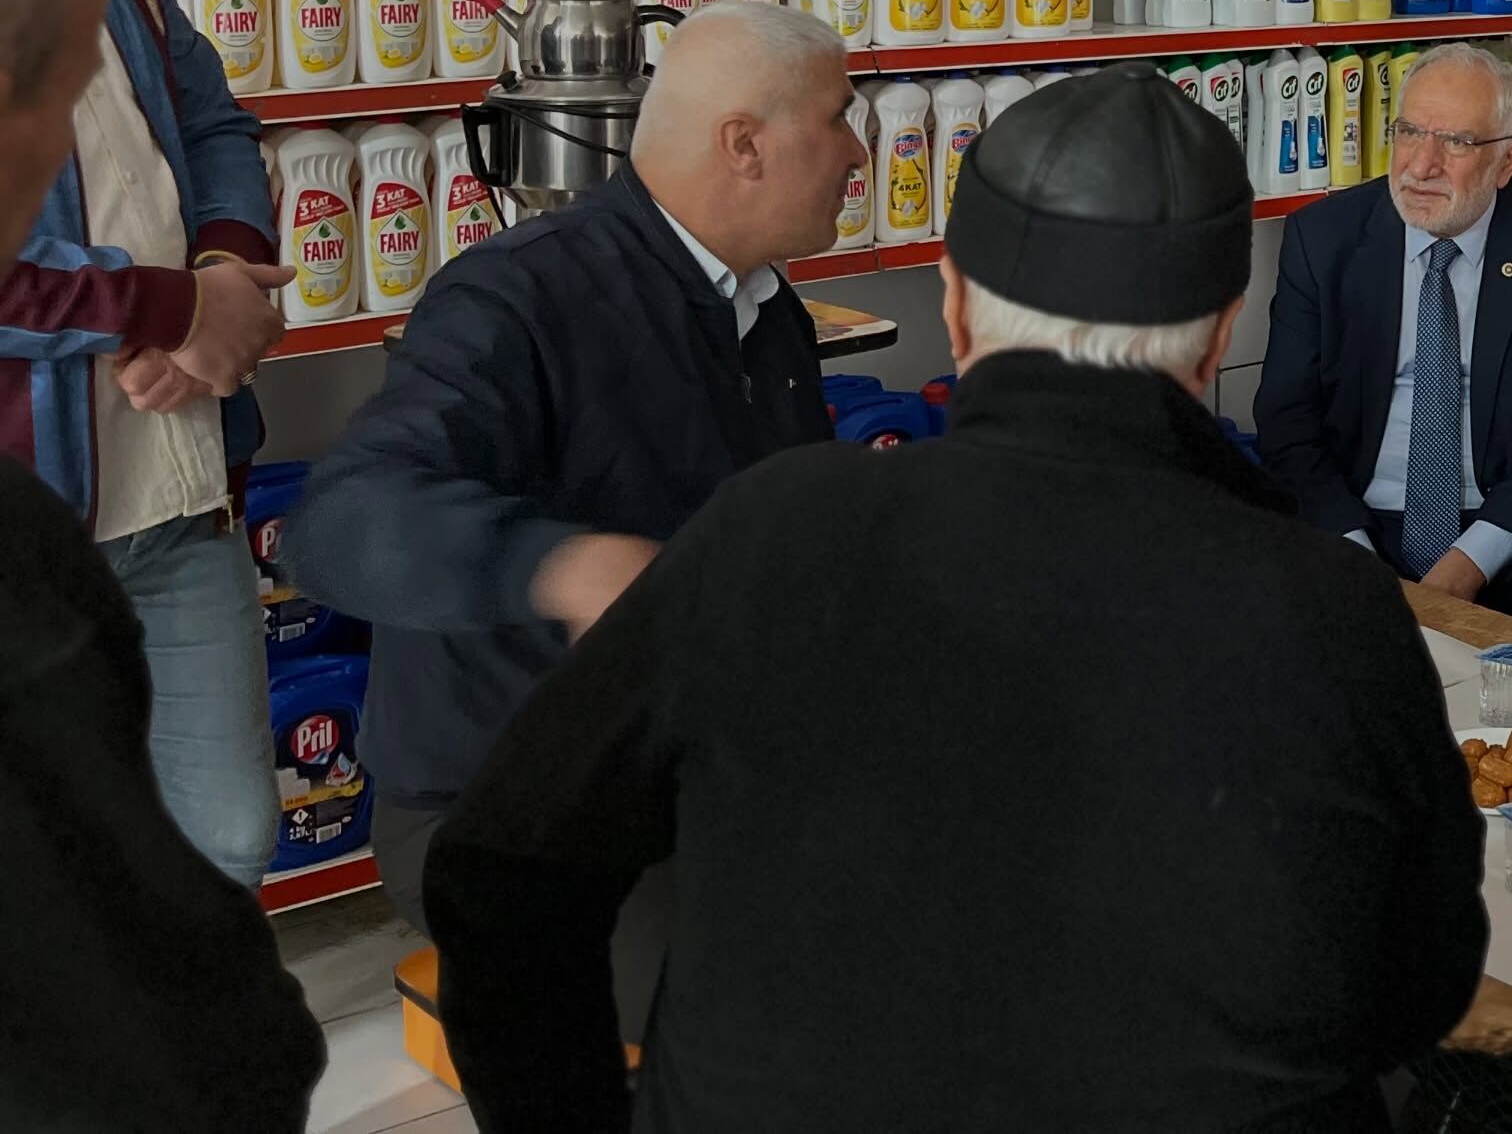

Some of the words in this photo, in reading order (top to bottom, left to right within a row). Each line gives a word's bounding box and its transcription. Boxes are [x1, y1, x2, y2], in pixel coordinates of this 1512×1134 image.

[215, 12, 257, 33] FAIRY
[301, 7, 342, 29] FAIRY
[380, 3, 419, 25] FAIRY
[1282, 78, 1298, 98] Cif
[1308, 74, 1324, 94] Cif
[1346, 74, 1359, 91] Cif
[299, 201, 309, 217] 3
[310, 195, 331, 209] KAT
[380, 231, 420, 254] FAIRY
[456, 221, 493, 244] FAIRY
[303, 239, 344, 263] FAIRY
[297, 720, 332, 758] Pril
